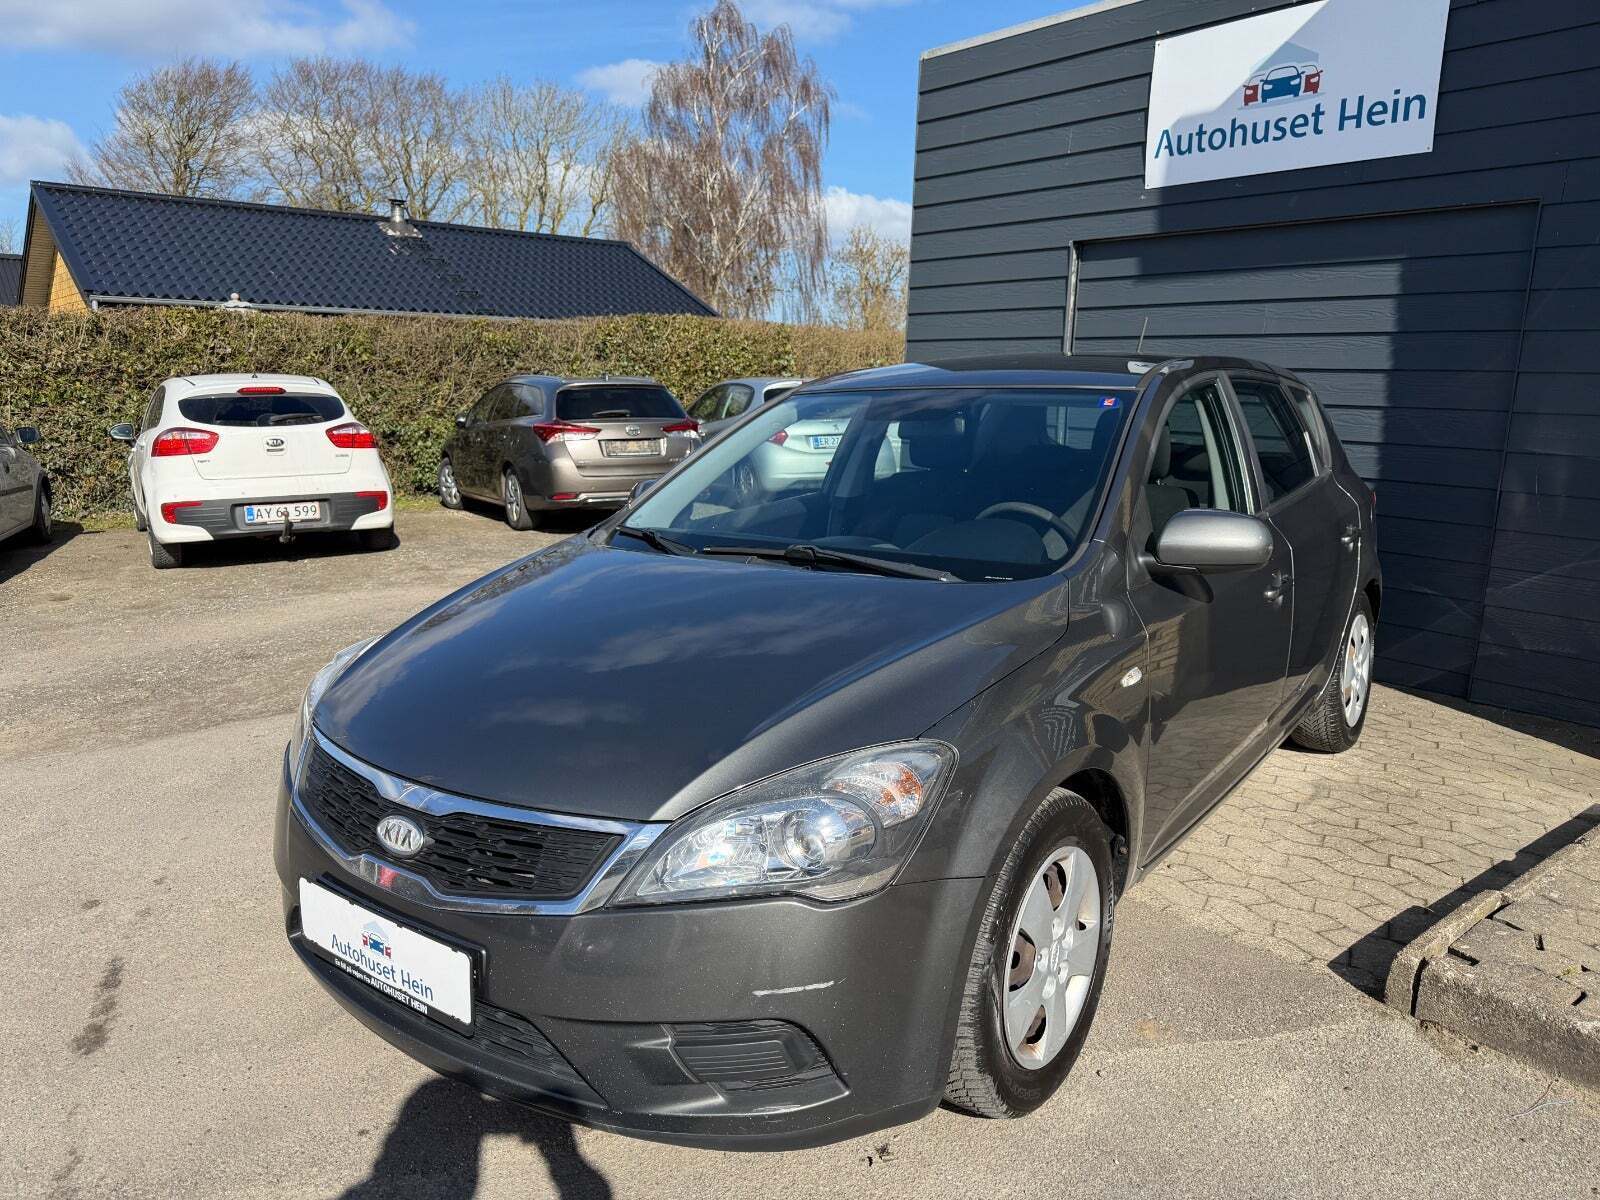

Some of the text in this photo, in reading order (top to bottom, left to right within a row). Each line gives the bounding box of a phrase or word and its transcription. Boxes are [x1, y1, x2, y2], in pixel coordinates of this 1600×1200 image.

[1154, 89, 1427, 159] Autohuset Hein
[256, 508, 272, 520] AY
[294, 505, 317, 517] 599
[383, 820, 413, 850] KIA
[331, 934, 434, 1001] Autohuset Hein
[370, 977, 410, 1006] AUTOHUSET
[410, 1000, 428, 1015] HEIN
